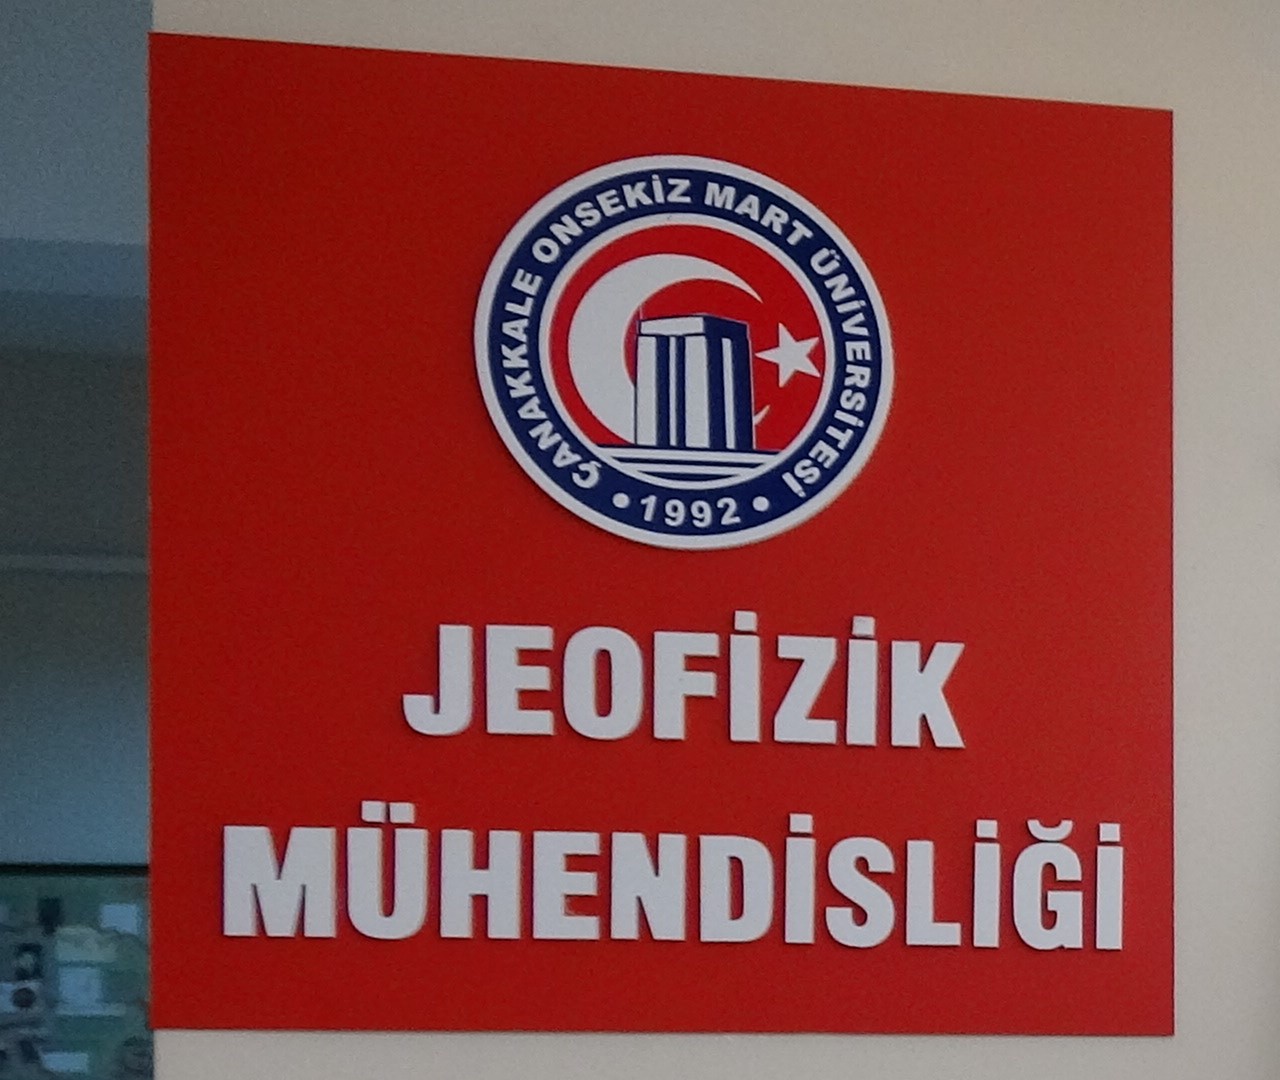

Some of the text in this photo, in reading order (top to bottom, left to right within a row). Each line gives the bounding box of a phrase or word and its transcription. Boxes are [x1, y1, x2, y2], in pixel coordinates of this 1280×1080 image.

[501, 174, 872, 497] ÇANAKKALE ONSEKİZ MART ÜNİVERSİTESİ
[640, 496, 742, 528] 1992
[402, 610, 966, 750] JEOFİZİK
[222, 800, 1125, 951] MÜHENDİSLİĞİ
